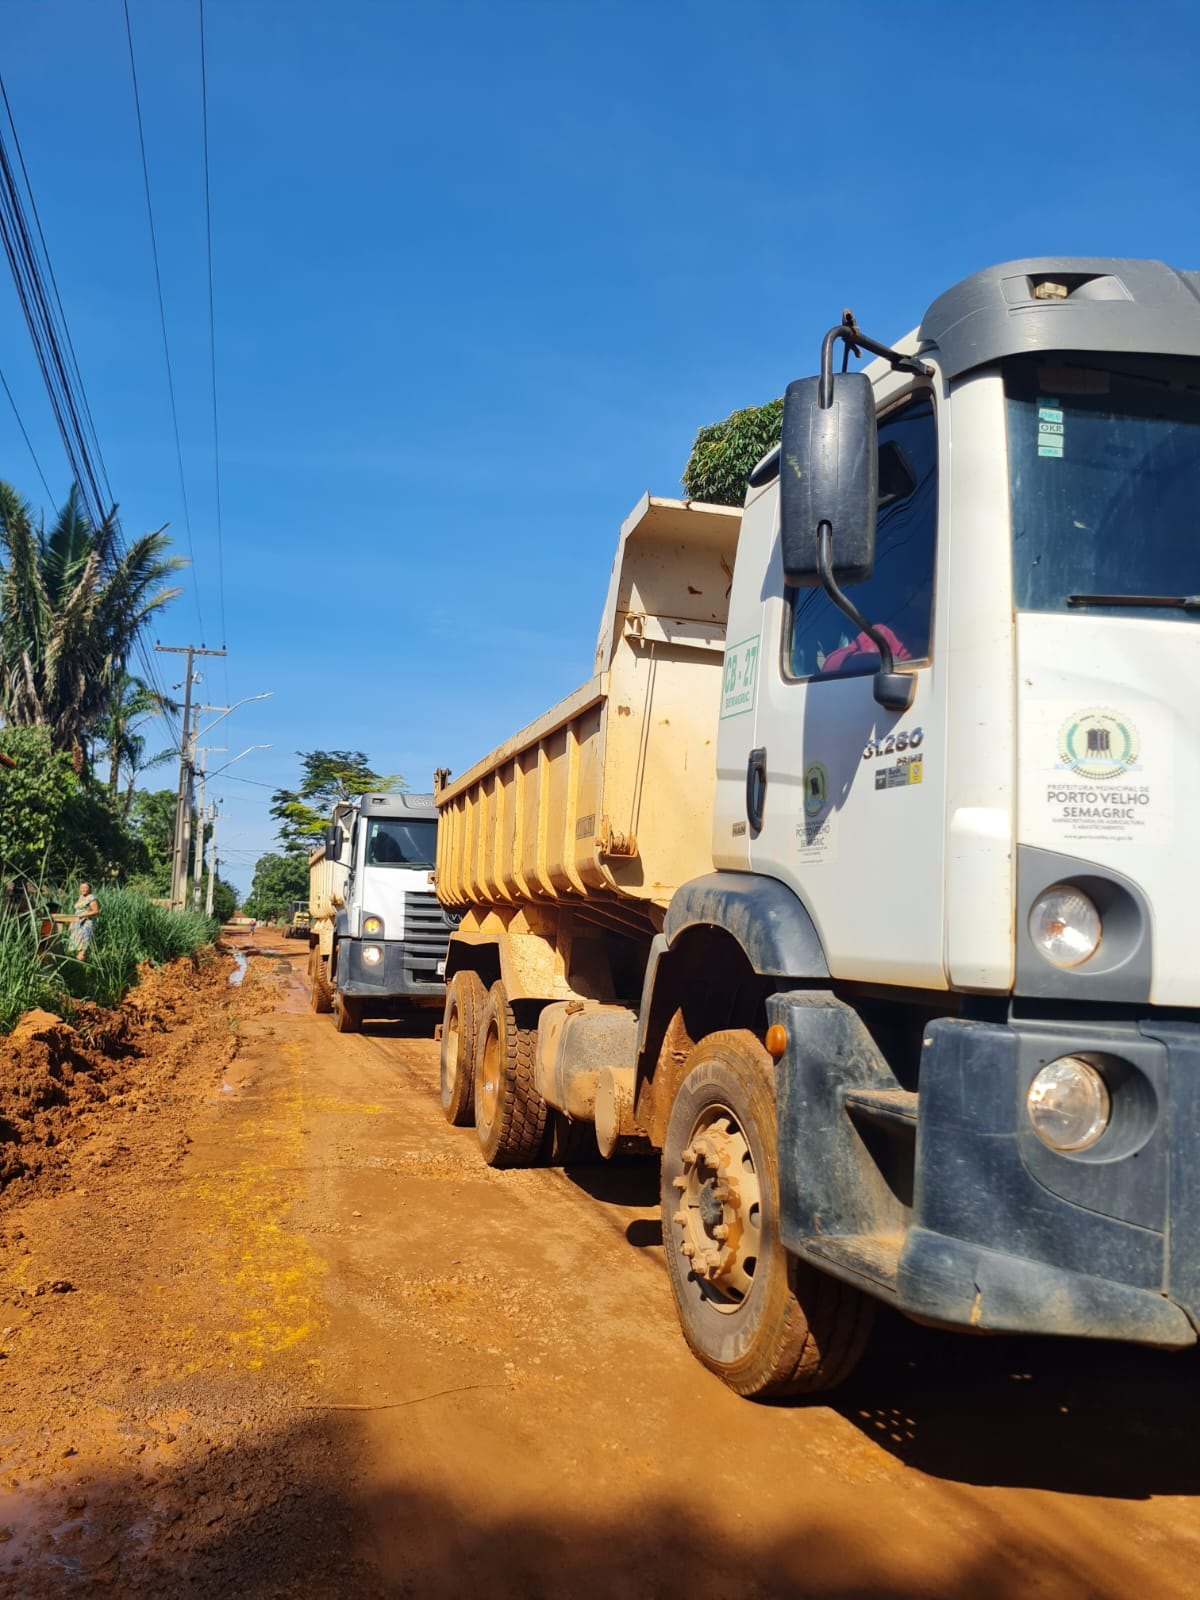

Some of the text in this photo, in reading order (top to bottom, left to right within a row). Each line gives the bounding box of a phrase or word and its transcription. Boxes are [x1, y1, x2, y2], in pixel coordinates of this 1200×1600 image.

[743, 646, 757, 687] 27
[725, 691, 750, 708] SEMAGRIC
[863, 726, 925, 760] 31.280
[1047, 791, 1150, 805] PORTO VELHO
[1063, 807, 1135, 819] SEMAGRIC
